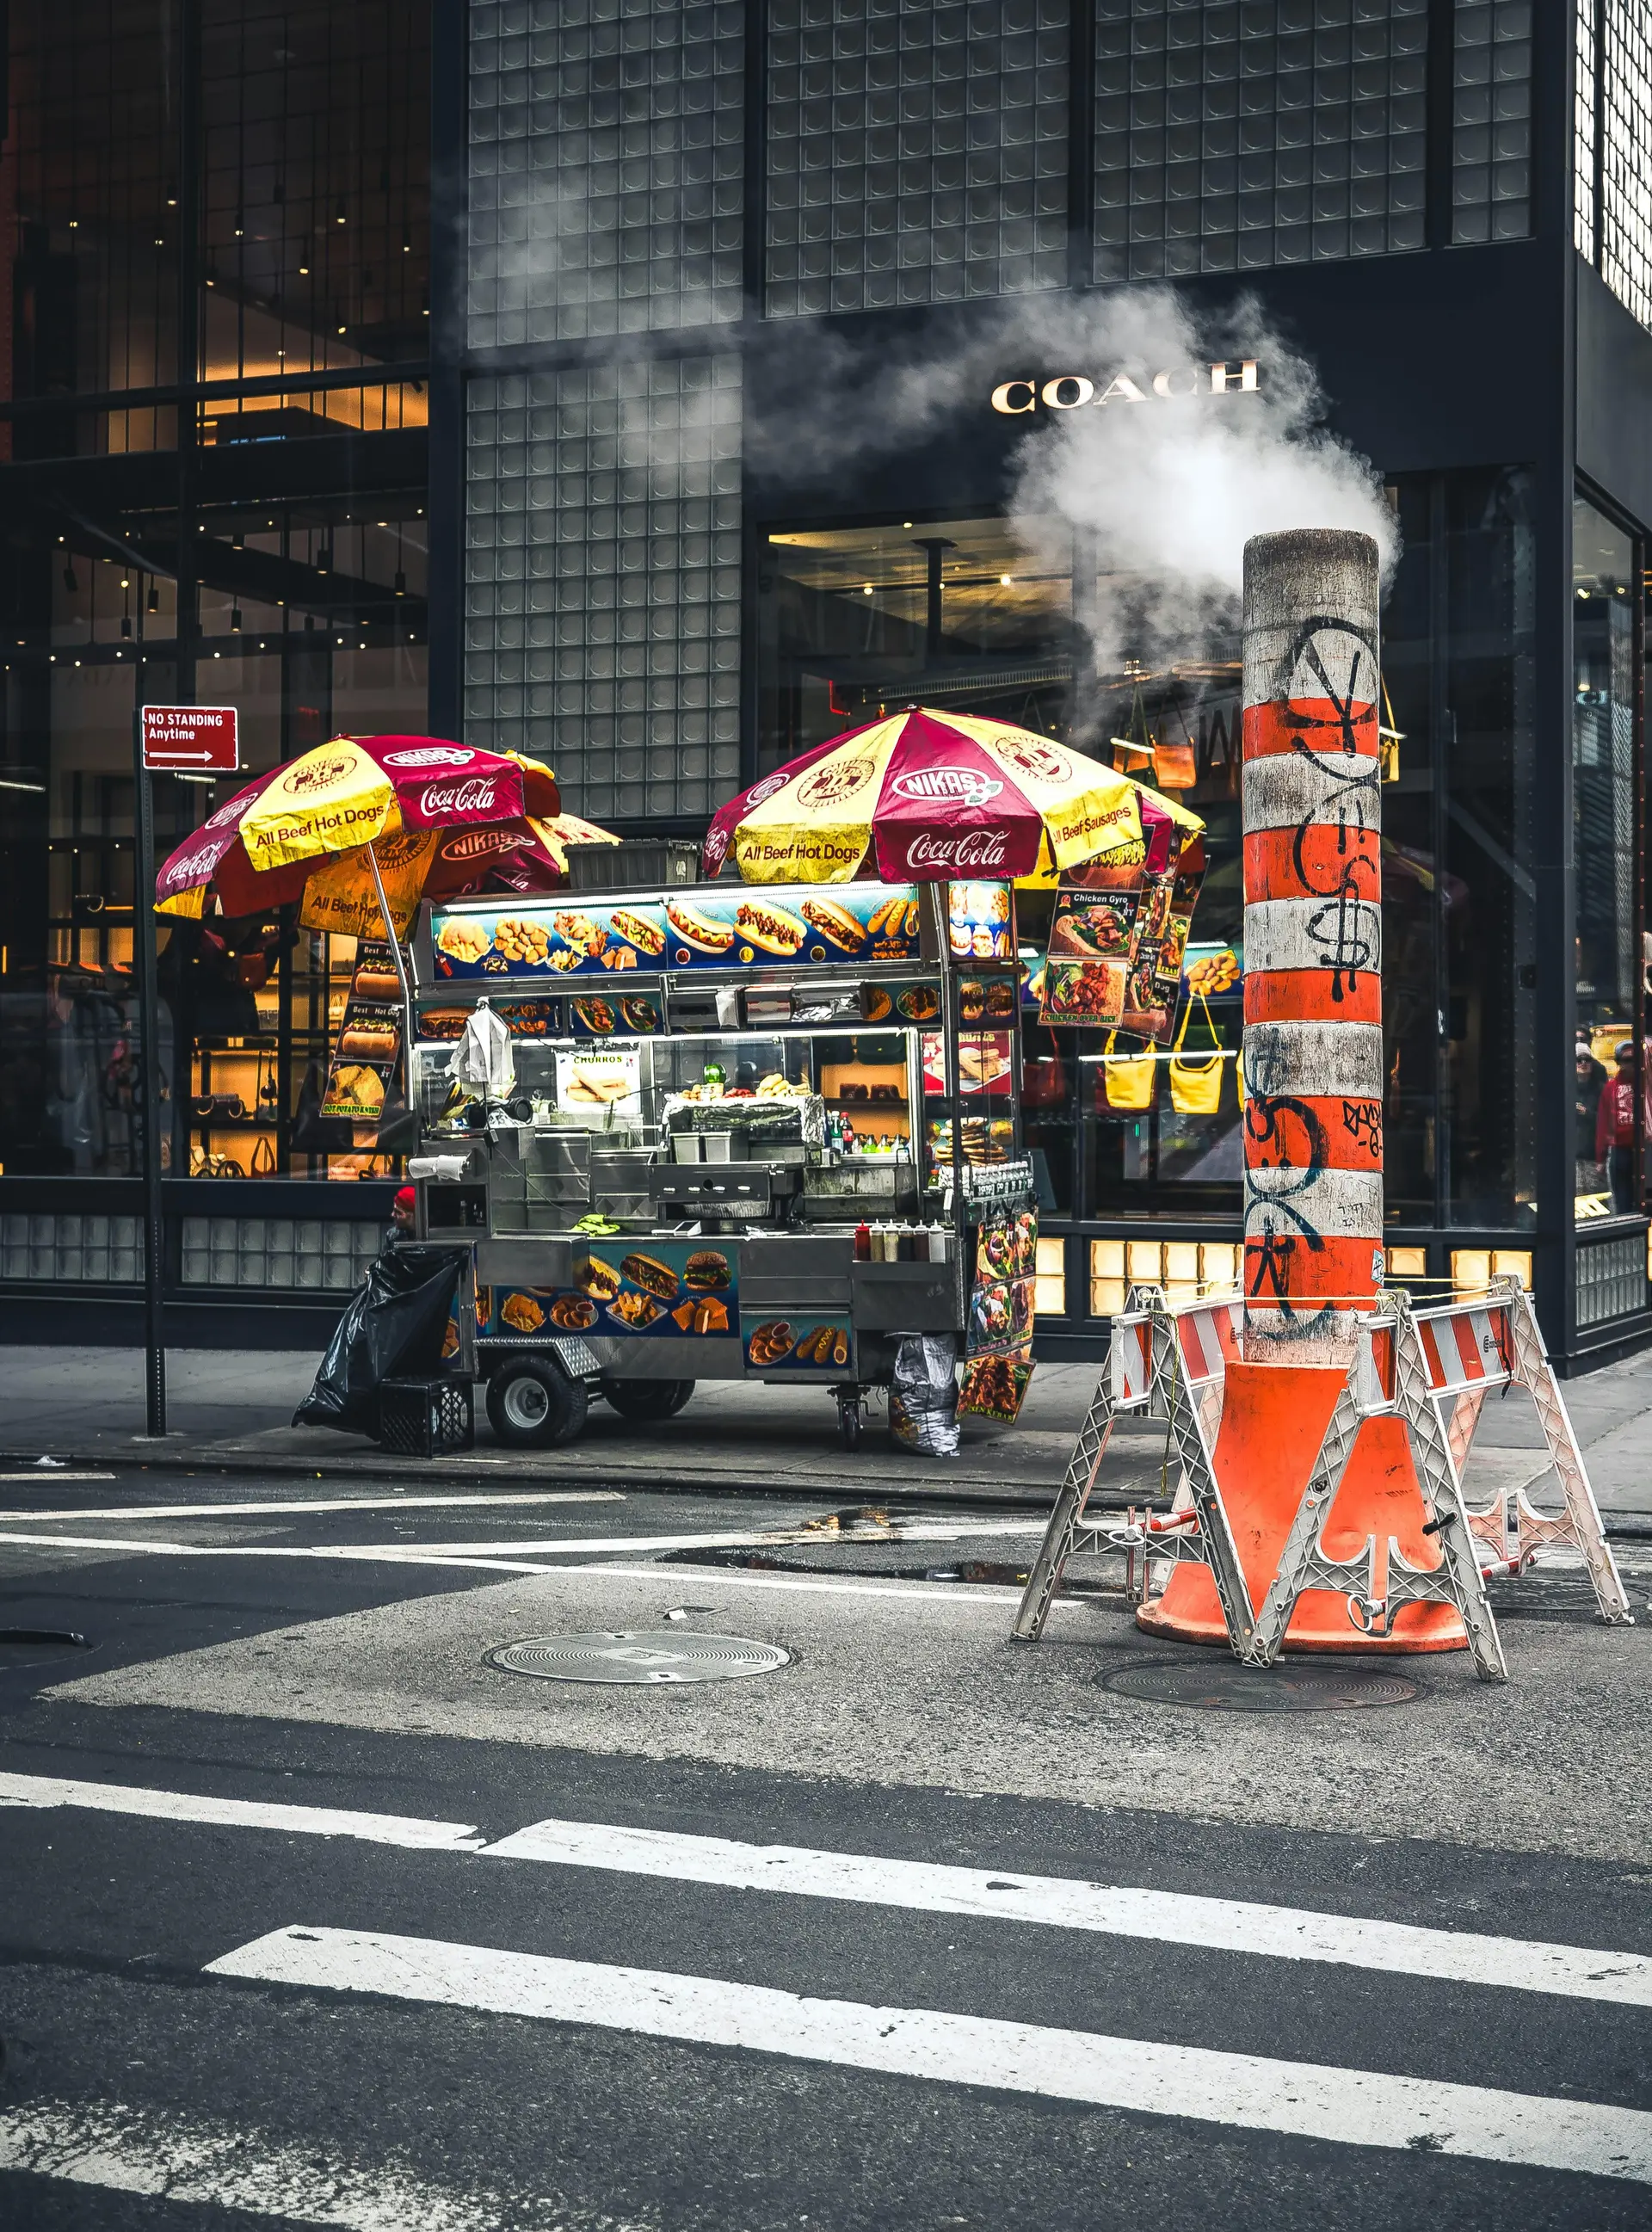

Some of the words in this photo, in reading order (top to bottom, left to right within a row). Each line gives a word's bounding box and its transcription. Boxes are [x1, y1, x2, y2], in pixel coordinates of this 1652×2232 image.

[991, 358, 1261, 414] COACH
[148, 712, 164, 725] NO
[167, 713, 224, 726] STANDING
[149, 727, 196, 742] Anytime
[906, 771, 977, 796] NIKAS
[256, 831, 274, 848] All
[278, 821, 312, 842] Beef
[315, 813, 342, 832] Hot
[344, 805, 385, 825] Dogs
[1063, 823, 1084, 842] Beef
[1084, 806, 1132, 832] Sausages
[453, 831, 513, 855] NIKAS
[907, 830, 1011, 868] Coca-Cola
[743, 847, 761, 860] All
[764, 844, 795, 860] Beef
[796, 844, 823, 860] Hot
[823, 844, 860, 863] Dogs
[311, 896, 330, 910] All
[330, 898, 359, 914] Beef
[1074, 893, 1107, 903] Chicken
[1109, 895, 1128, 905] Gyro
[364, 946, 379, 955] Best
[353, 1005, 368, 1014] Best
[374, 1007, 386, 1015] Hot
[574, 1056, 623, 1064] CHURROS
